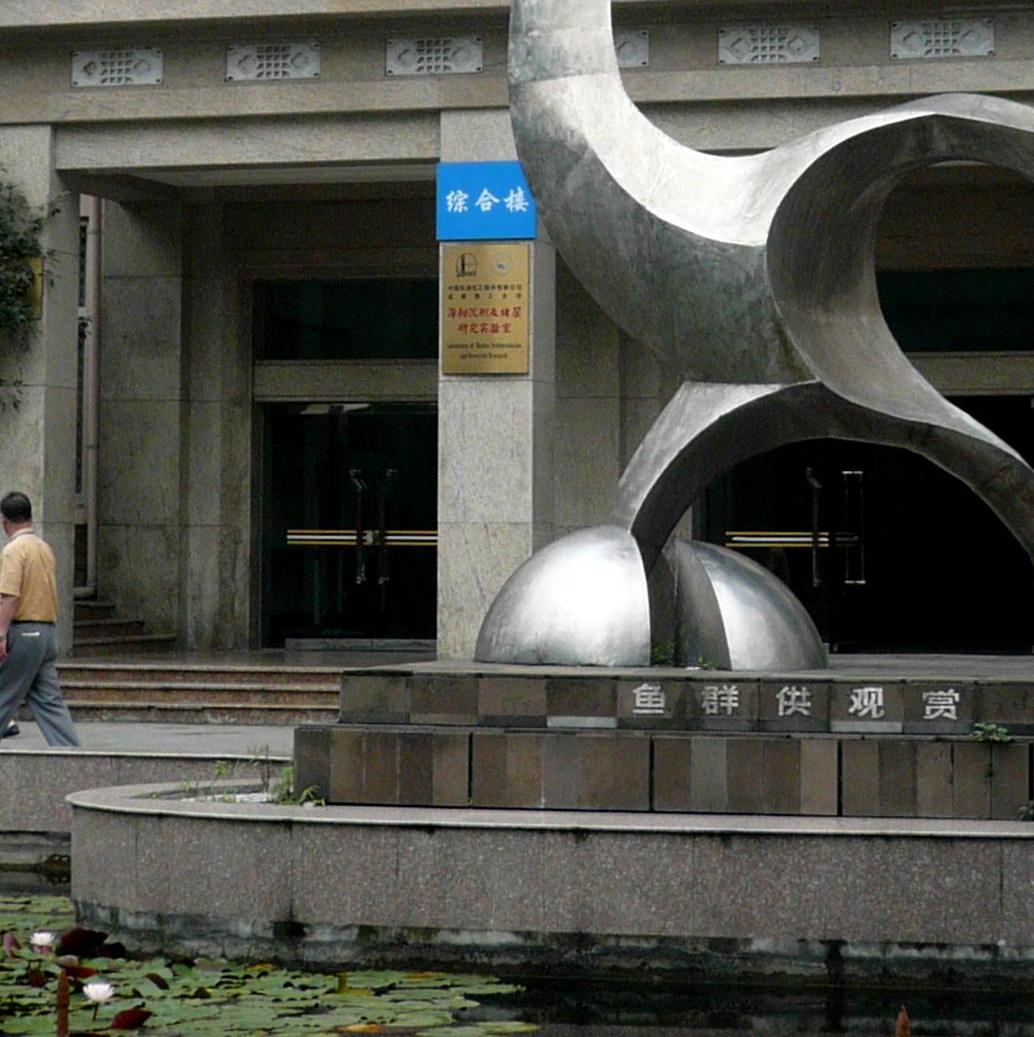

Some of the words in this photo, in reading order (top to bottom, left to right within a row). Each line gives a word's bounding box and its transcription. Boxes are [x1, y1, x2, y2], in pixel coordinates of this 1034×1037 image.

[446, 186, 529, 213] 综合楼
[632, 683, 960, 720] 鱼群供观赏
